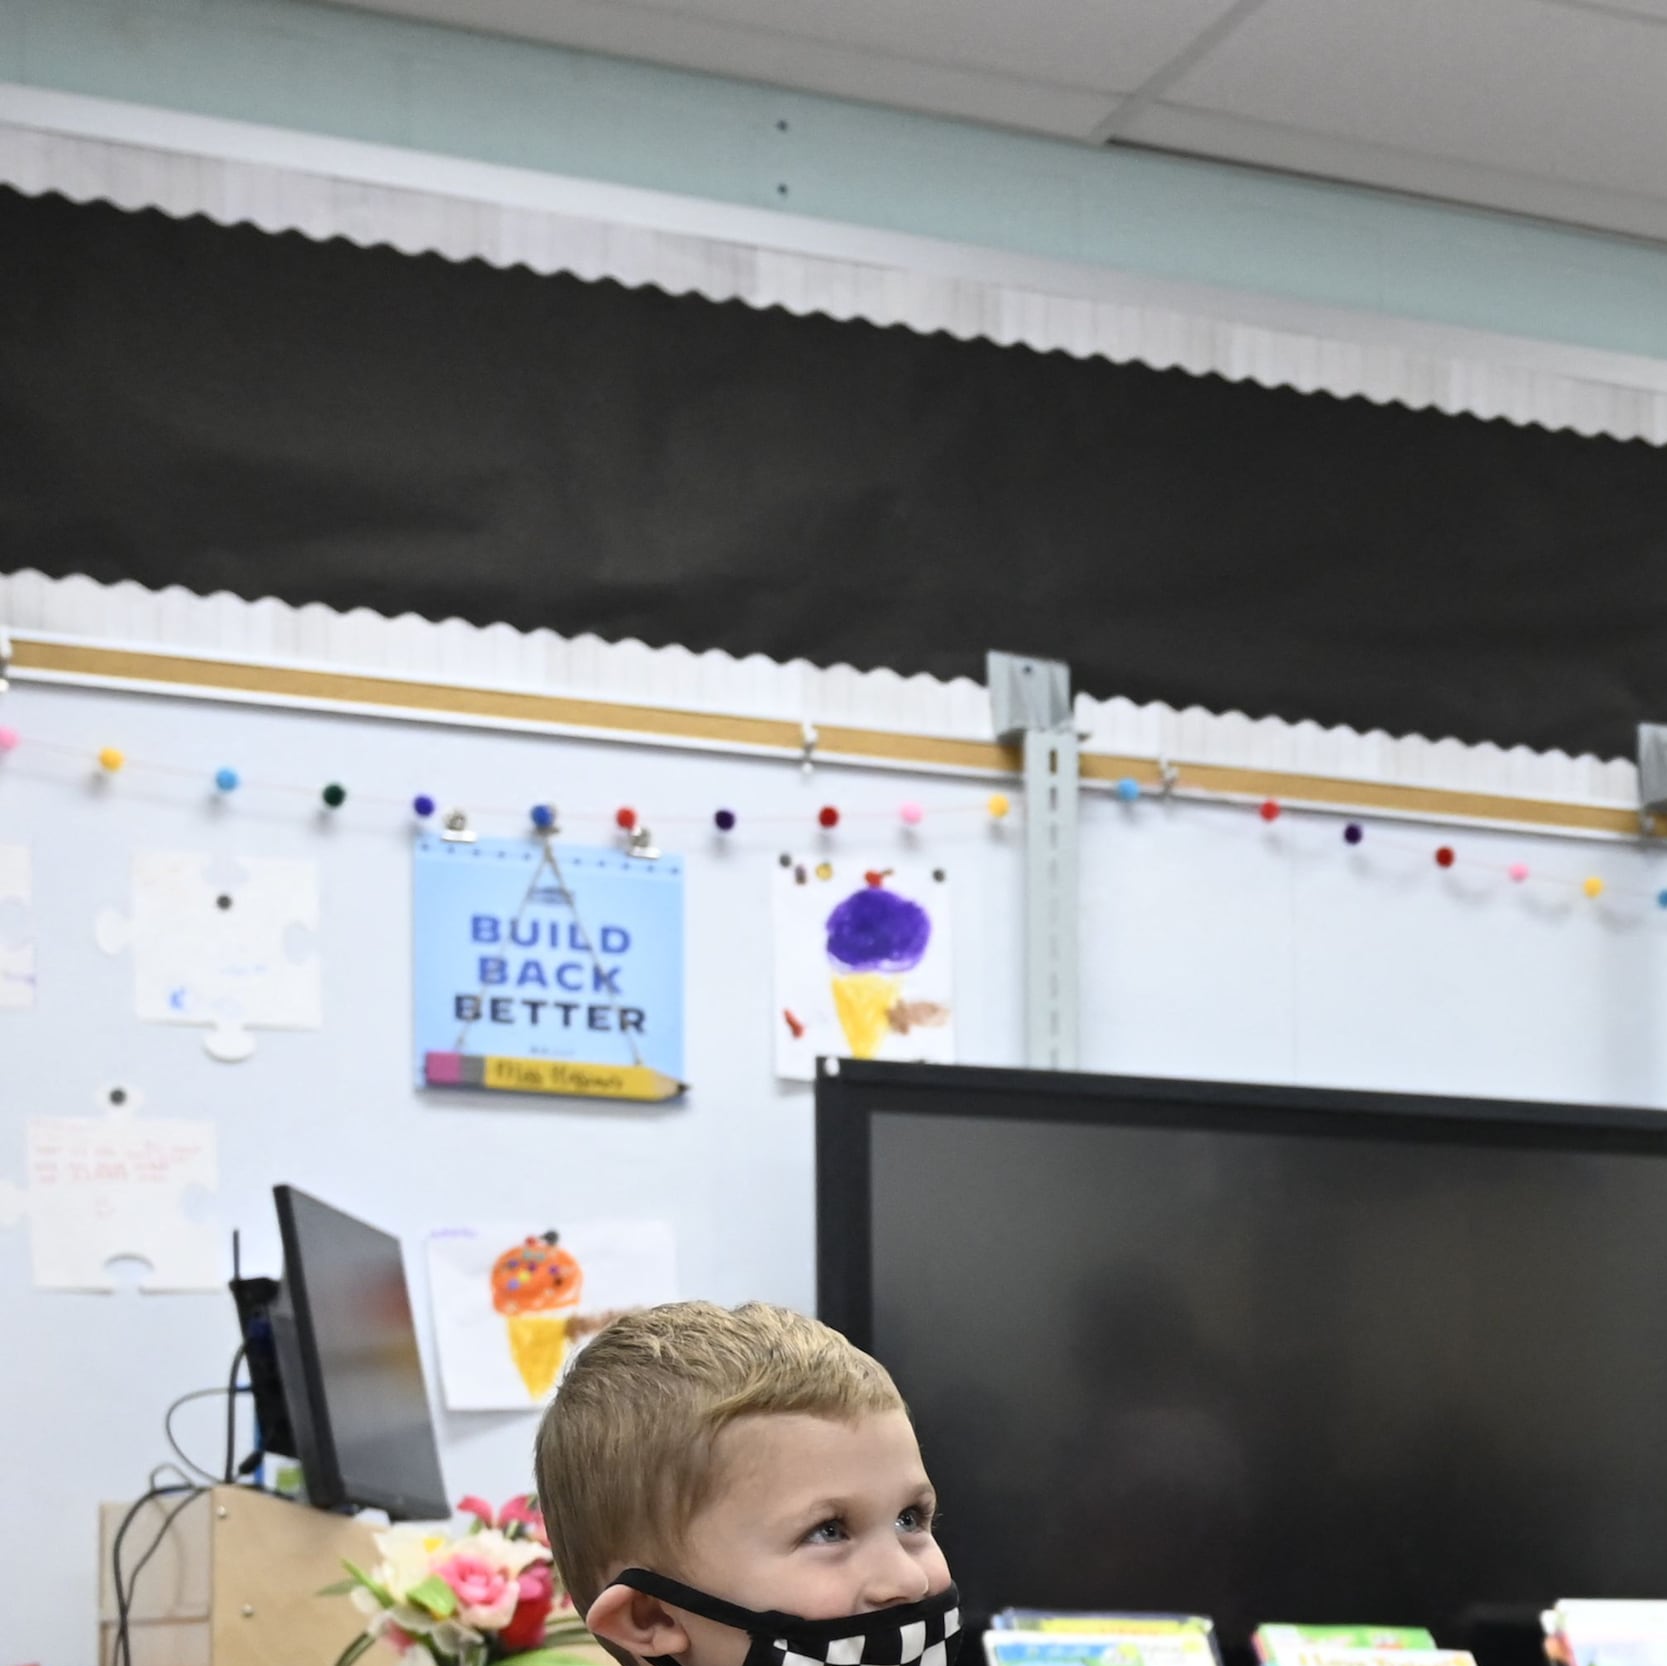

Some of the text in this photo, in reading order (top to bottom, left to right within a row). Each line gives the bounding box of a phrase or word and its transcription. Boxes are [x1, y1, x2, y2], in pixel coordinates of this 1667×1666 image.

[470, 914, 632, 955] BUILD
[477, 955, 623, 995] BACK
[453, 994, 647, 1034] BETTER
